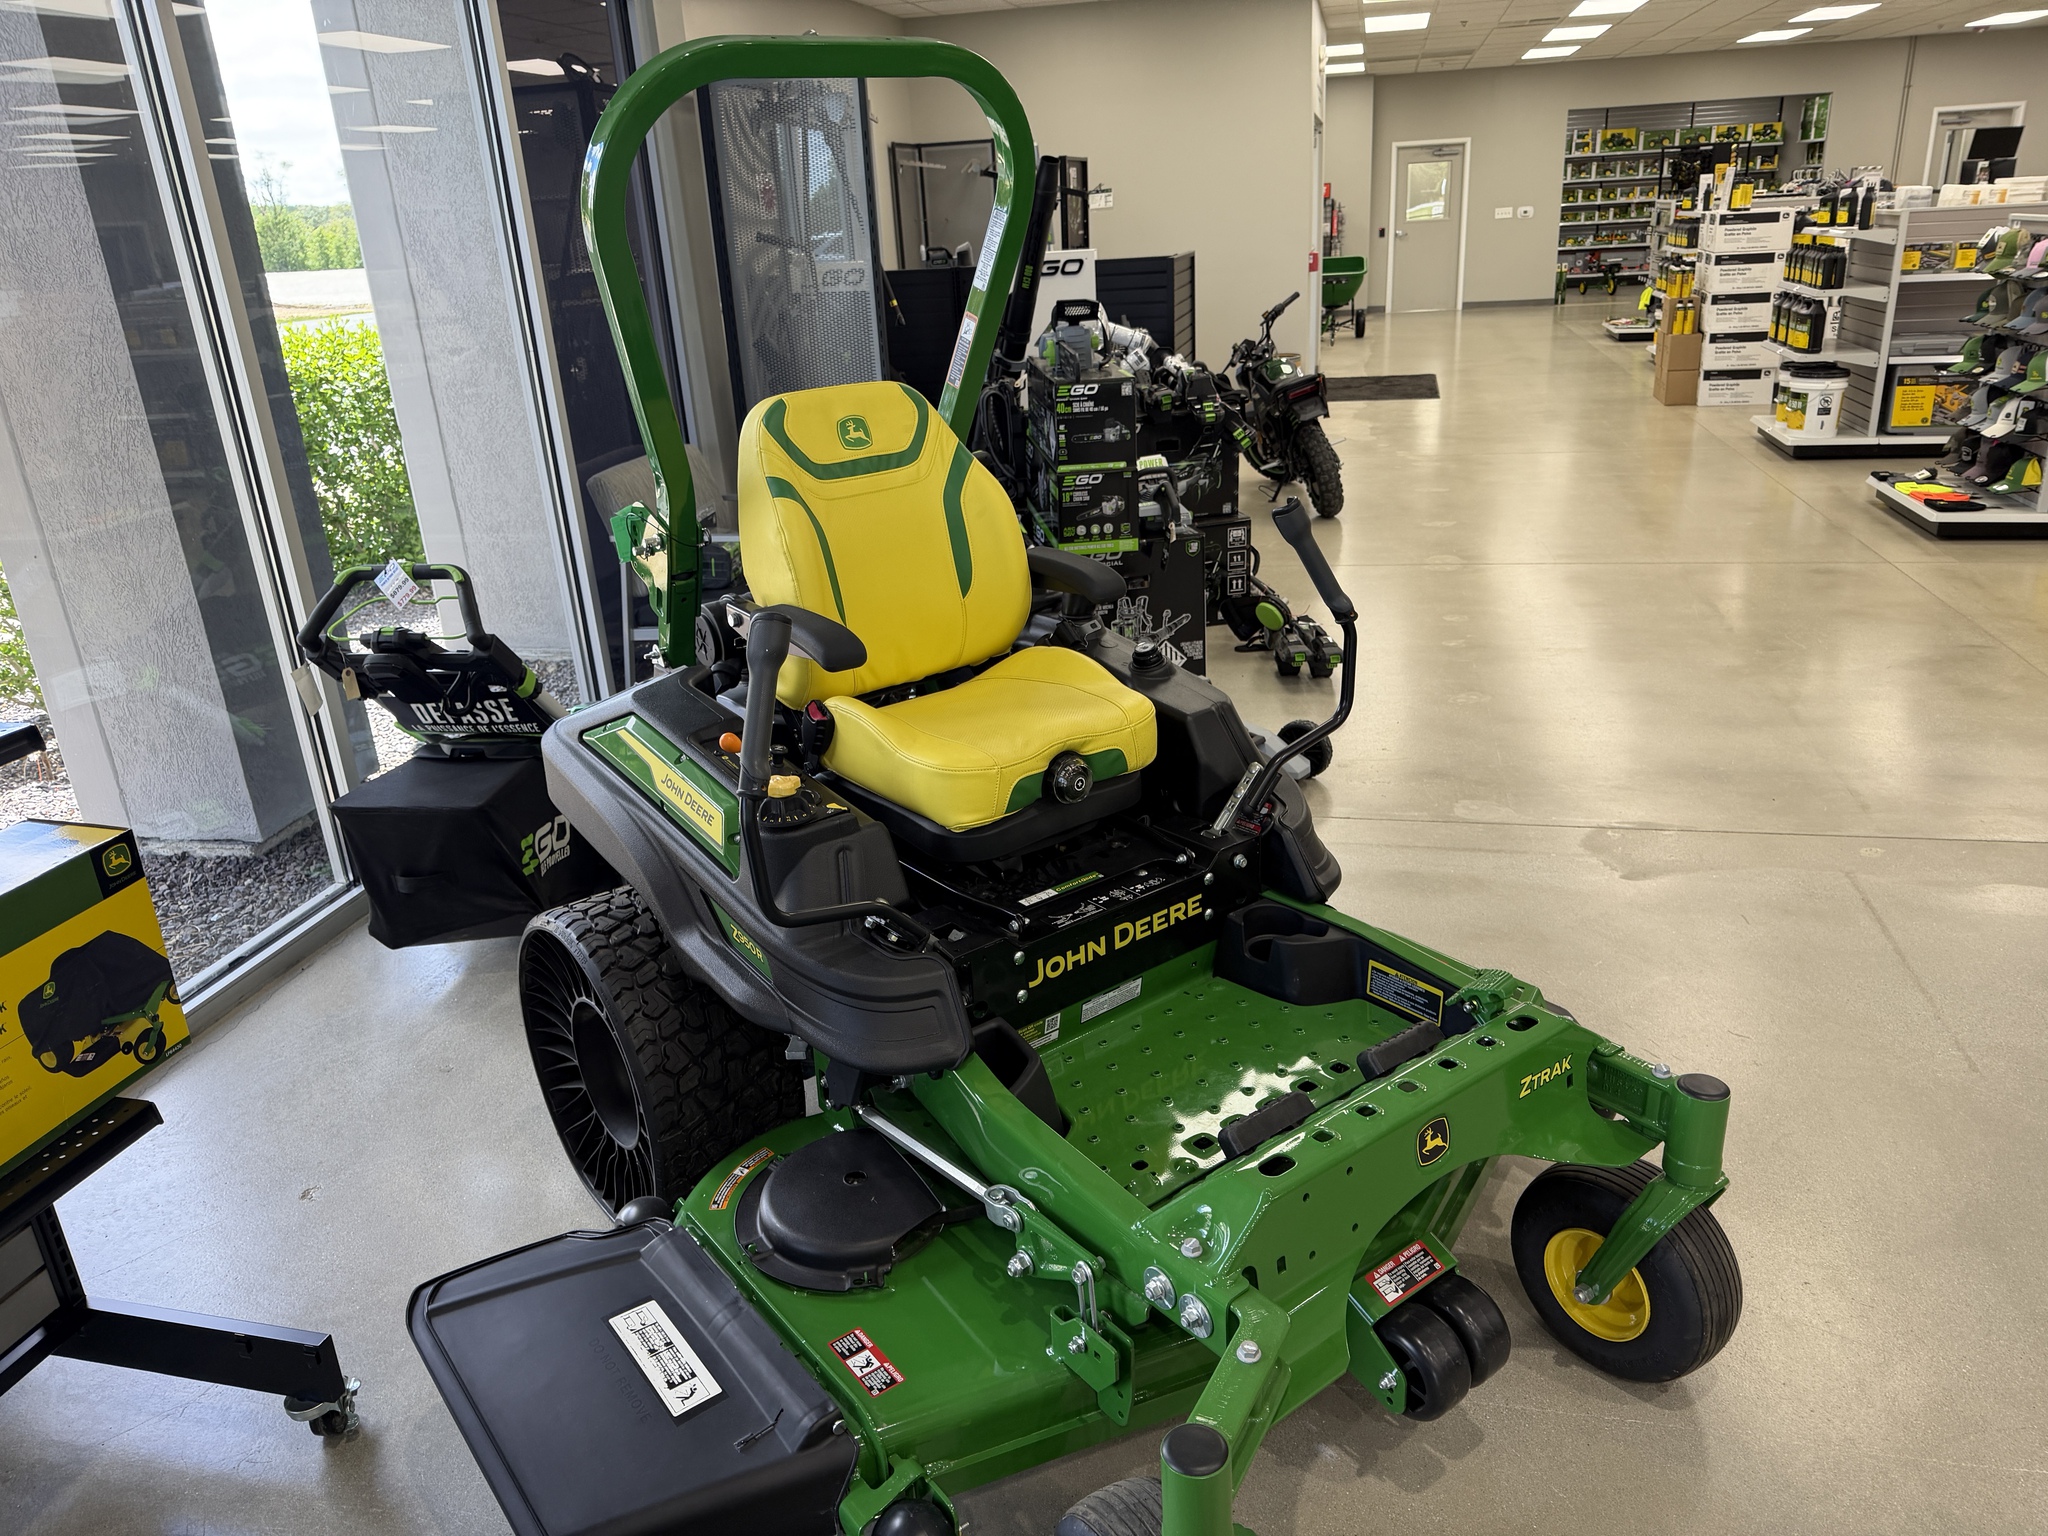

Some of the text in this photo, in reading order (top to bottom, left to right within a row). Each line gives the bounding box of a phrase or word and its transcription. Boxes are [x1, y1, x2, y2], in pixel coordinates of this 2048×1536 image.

[1041, 258, 1084, 276] GO
[1057, 383, 1099, 397] EGO
[1138, 457, 1163, 469] POWER
[1062, 473, 1103, 486] EGO
[1090, 551, 1123, 561] GO
[660, 773, 715, 827] JOHN DEERE
[730, 923, 764, 963] Z950R
[1028, 935, 1106, 989] JOHN
[1114, 893, 1203, 950] DEERE
[1519, 1053, 1574, 1099] ZTRAK
[1377, 1260, 1396, 1275] DANGER
[1402, 1243, 1421, 1258] PELIGRO
[588, 1336, 653, 1424] DO NOT REMOVE
